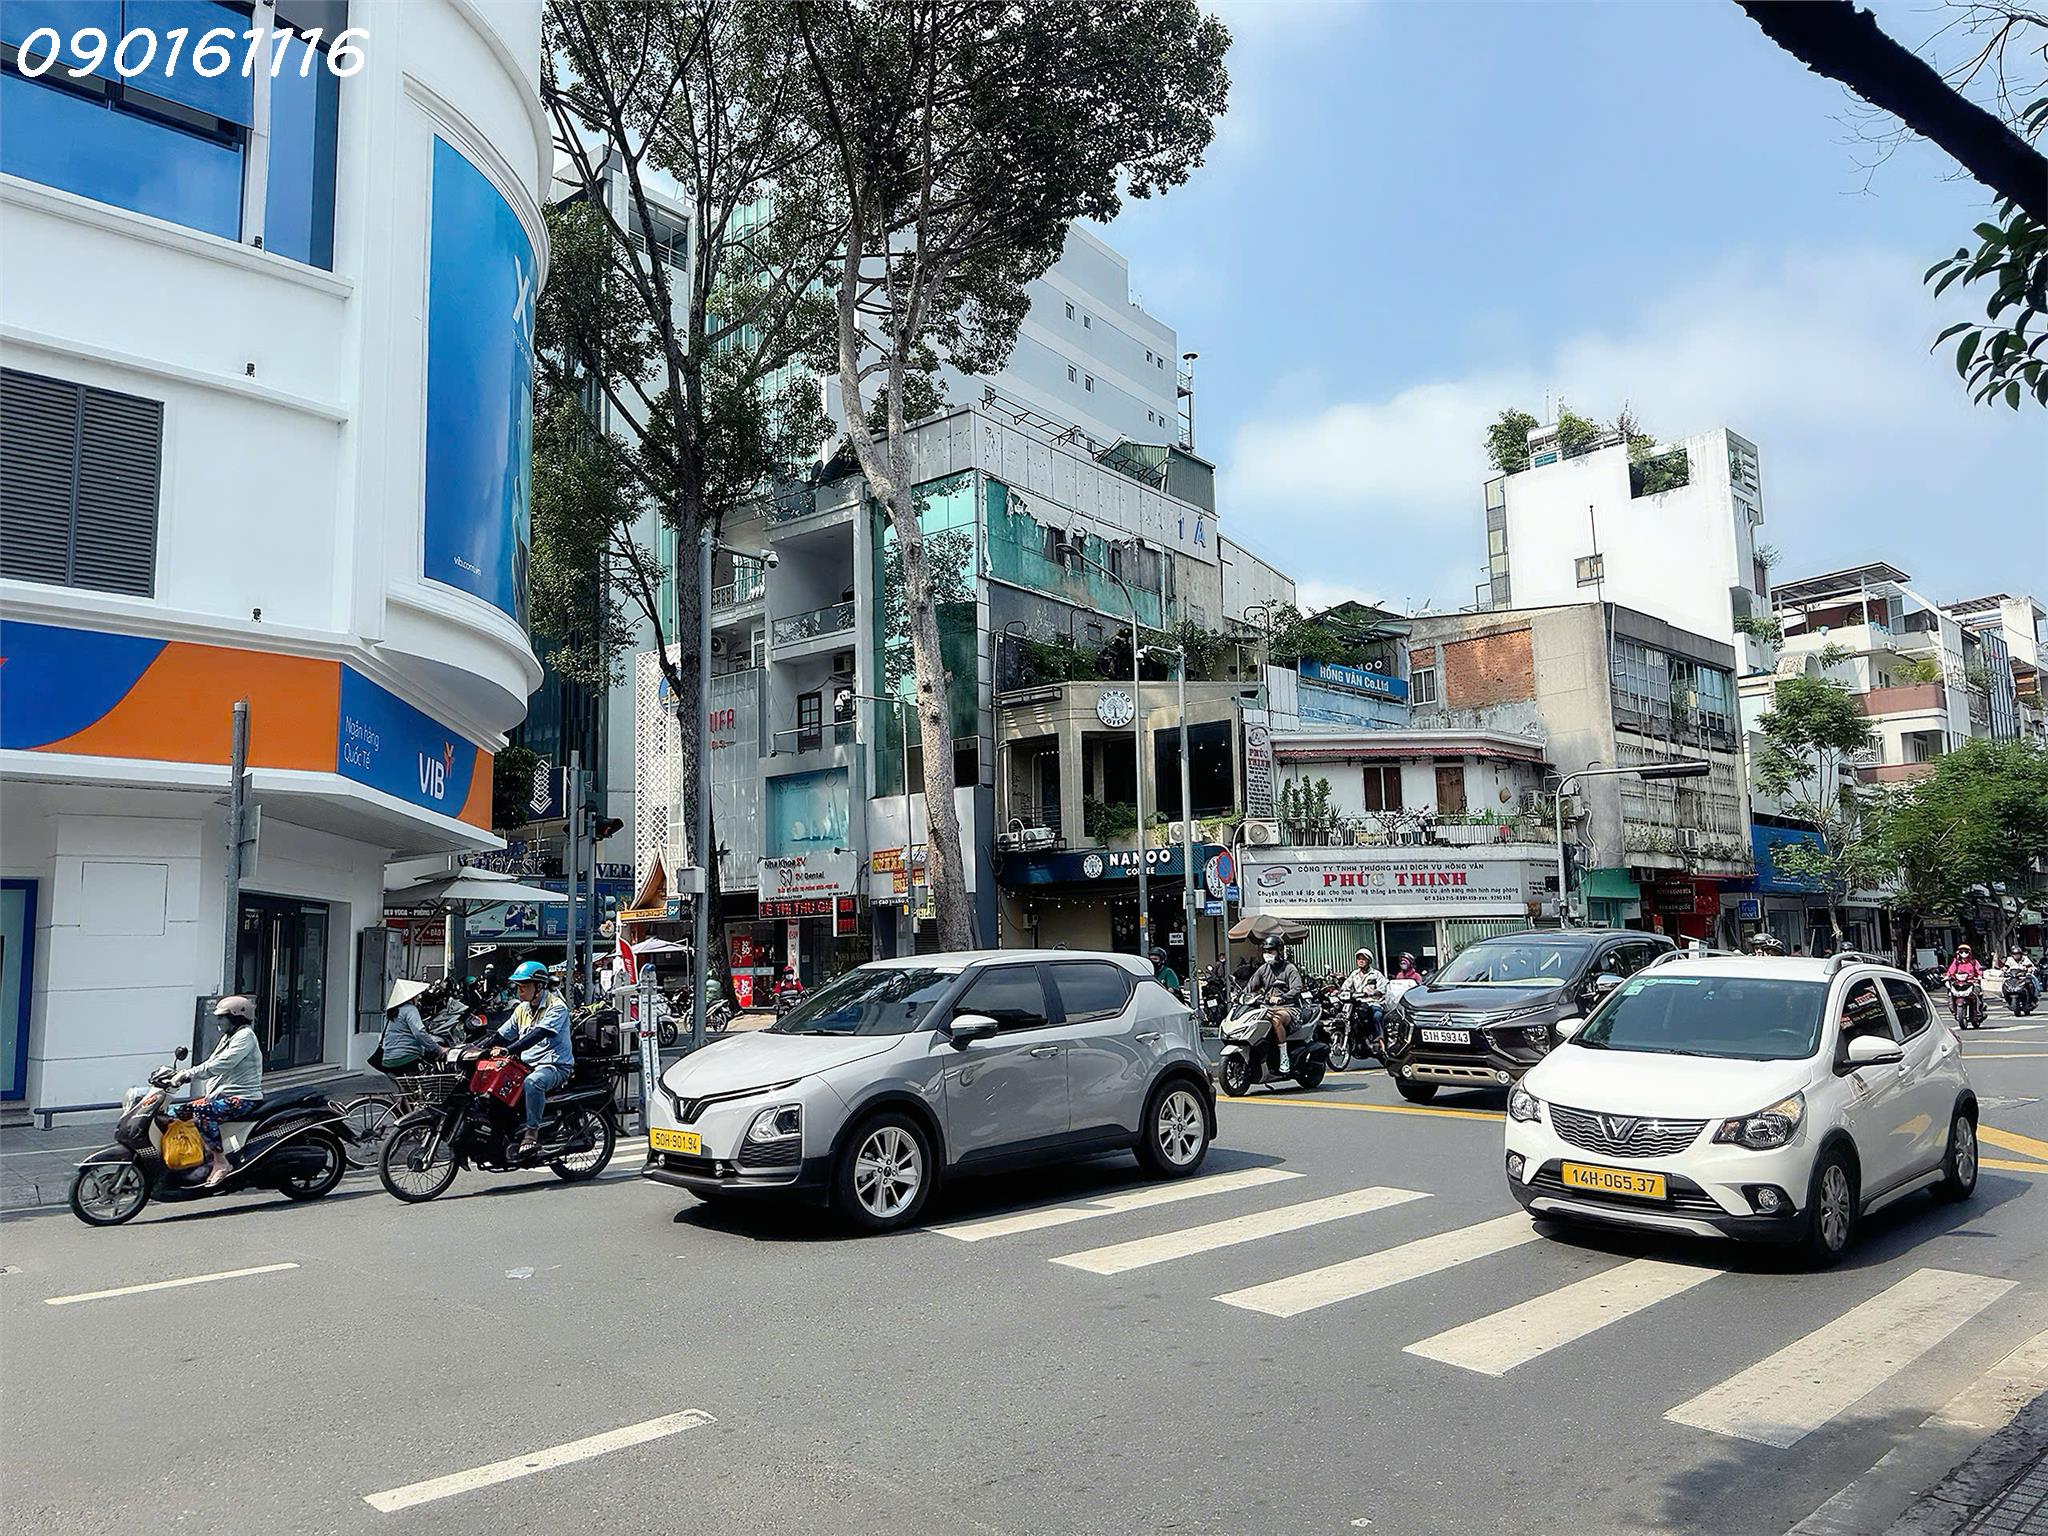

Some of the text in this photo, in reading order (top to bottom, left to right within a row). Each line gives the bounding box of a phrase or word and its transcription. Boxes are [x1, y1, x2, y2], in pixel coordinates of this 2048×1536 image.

[345, 716, 380, 752] Ngân hàng
[343, 743, 362, 767] Quốc
[419, 752, 445, 800] VIB
[1322, 871, 1467, 888] PHÚC THỊNH
[1423, 1031, 1439, 1041] 51H
[655, 1133, 697, 1150] 50H-901.94
[1572, 1169, 1655, 1193] 14H-065.37
